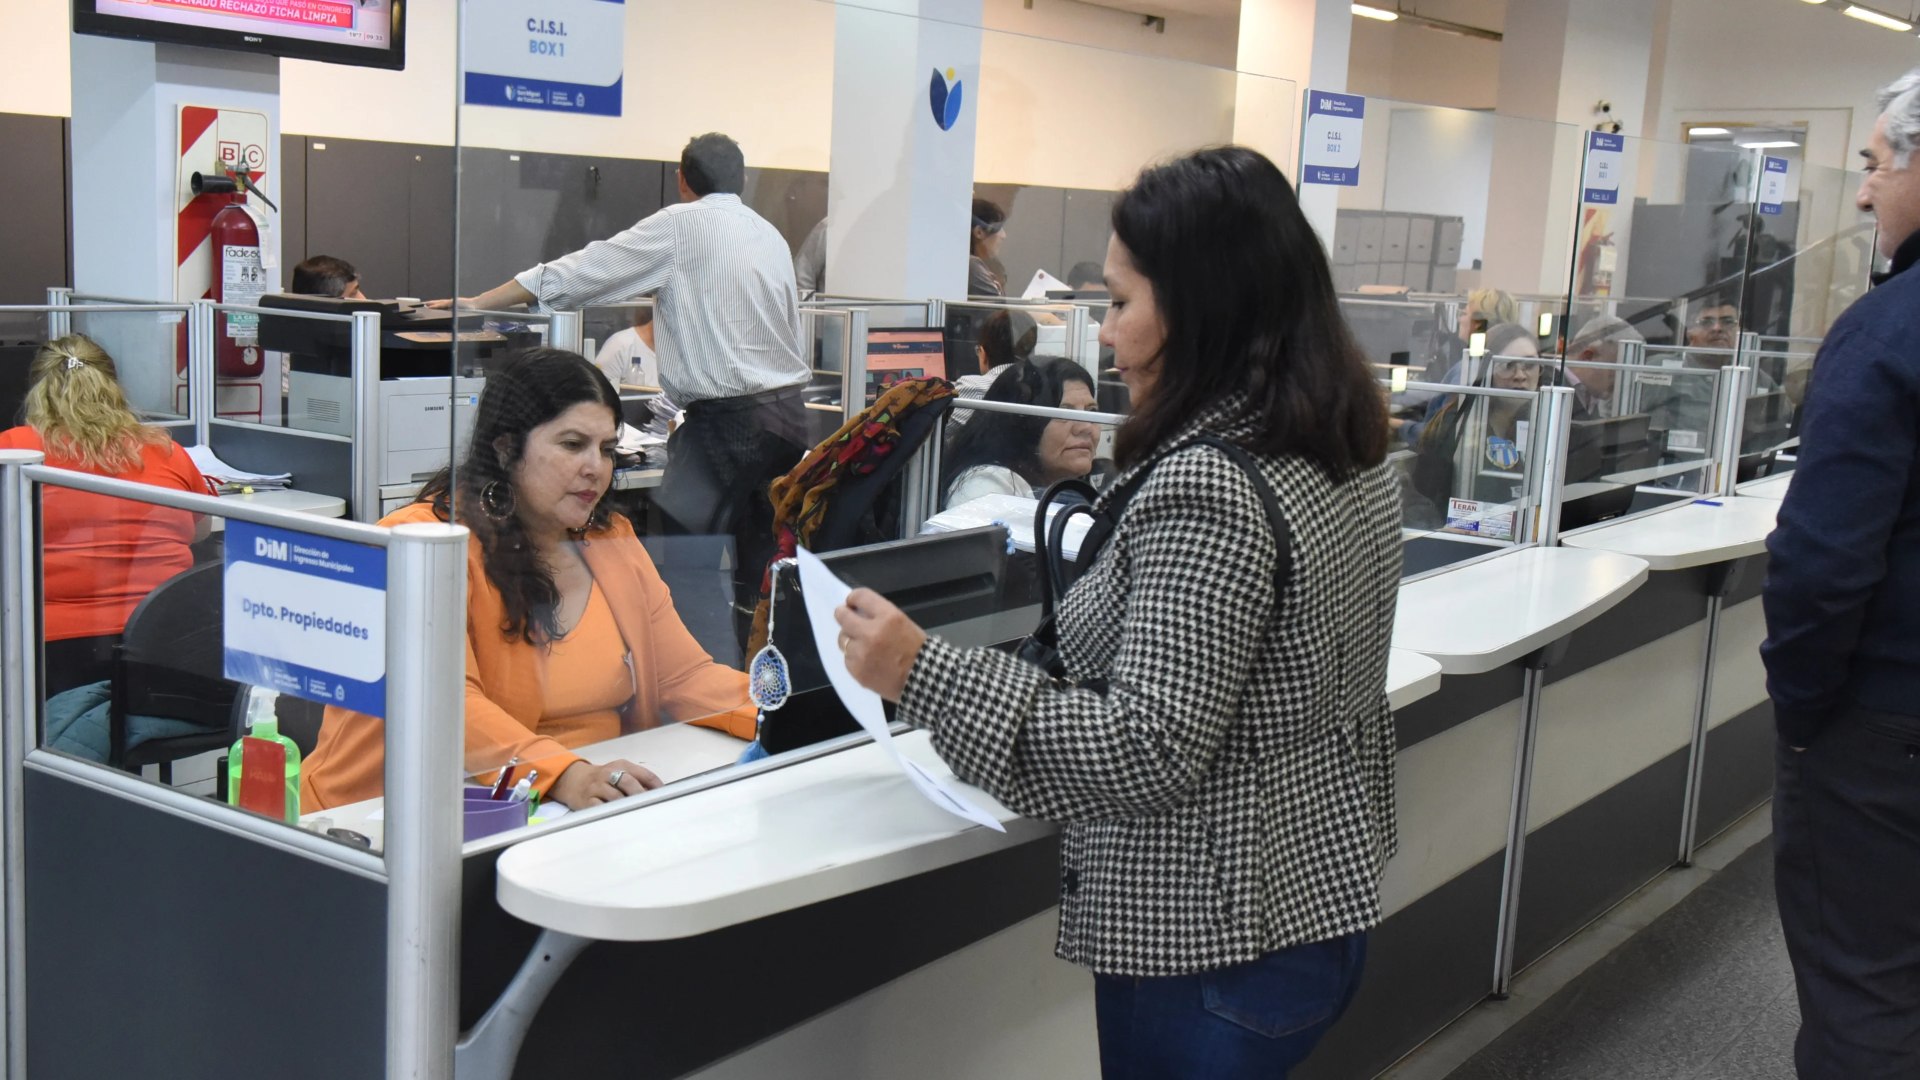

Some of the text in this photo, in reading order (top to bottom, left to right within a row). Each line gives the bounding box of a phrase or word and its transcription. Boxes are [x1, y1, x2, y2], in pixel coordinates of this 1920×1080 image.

[175, 0, 337, 23] NADO RECHAZÓ FICHA LIMPIA
[307, 2, 317, 10] EN
[317, 4, 351, 14] CONGRESO
[527, 18, 567, 36] C.I.S.I.
[244, 35, 263, 43] SONY
[529, 39, 565, 57] BOX 1
[222, 147, 259, 163] B C
[255, 536, 288, 562] DiM
[242, 598, 369, 640] Dpto. Propiedades
